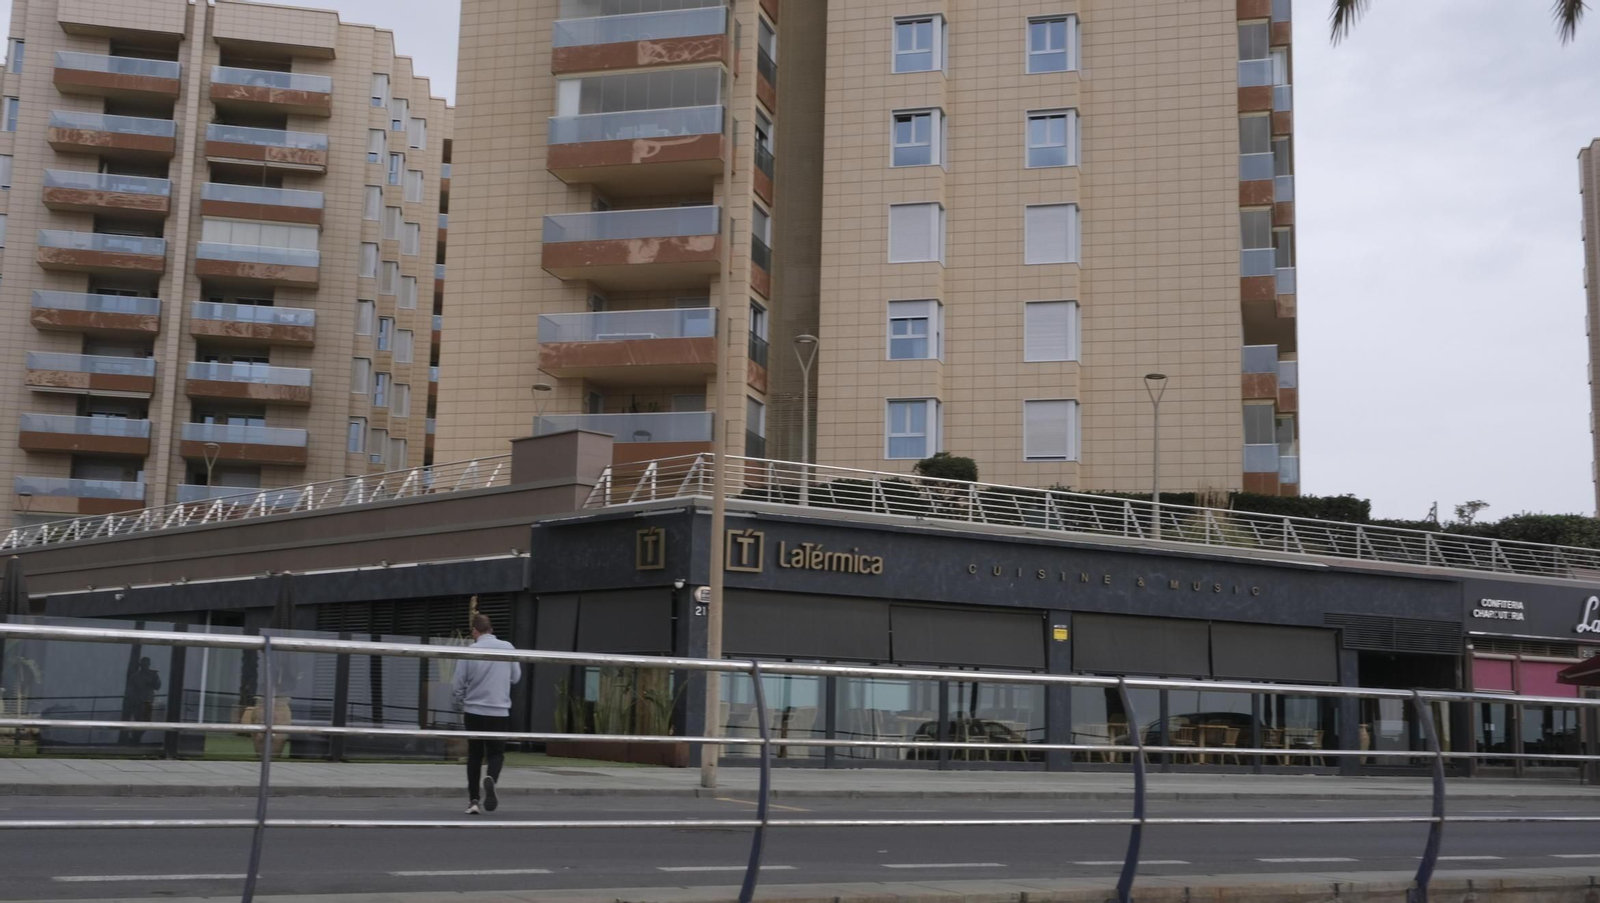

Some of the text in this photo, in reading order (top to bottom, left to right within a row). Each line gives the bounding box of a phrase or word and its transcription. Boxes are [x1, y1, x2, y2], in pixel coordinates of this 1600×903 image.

[779, 540, 883, 574] LaTérmica
[968, 563, 1260, 596] CUISINE & MUSIC
[1481, 598, 1524, 610] CONFITERIA
